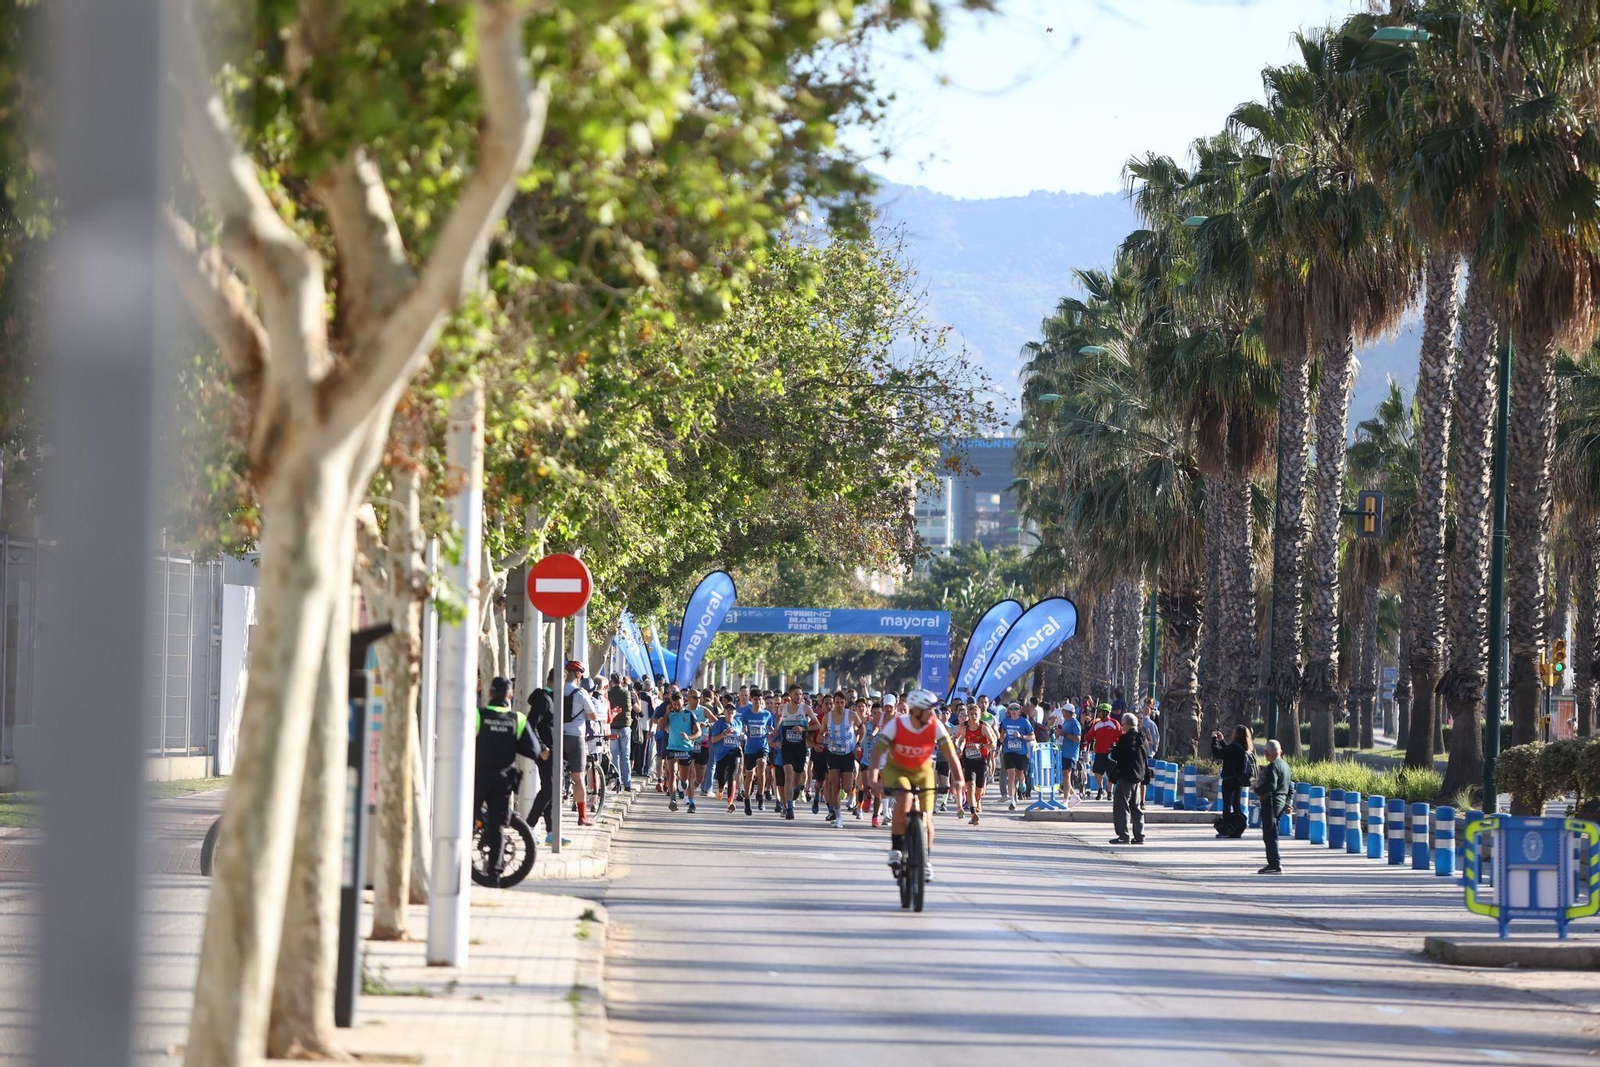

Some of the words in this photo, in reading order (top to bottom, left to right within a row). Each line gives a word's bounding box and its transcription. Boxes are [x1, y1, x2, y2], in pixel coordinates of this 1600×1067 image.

[683, 591, 724, 662] mayoral
[880, 615, 939, 630] mayoral
[963, 617, 1010, 685] mayoral
[993, 615, 1061, 681] mayoral
